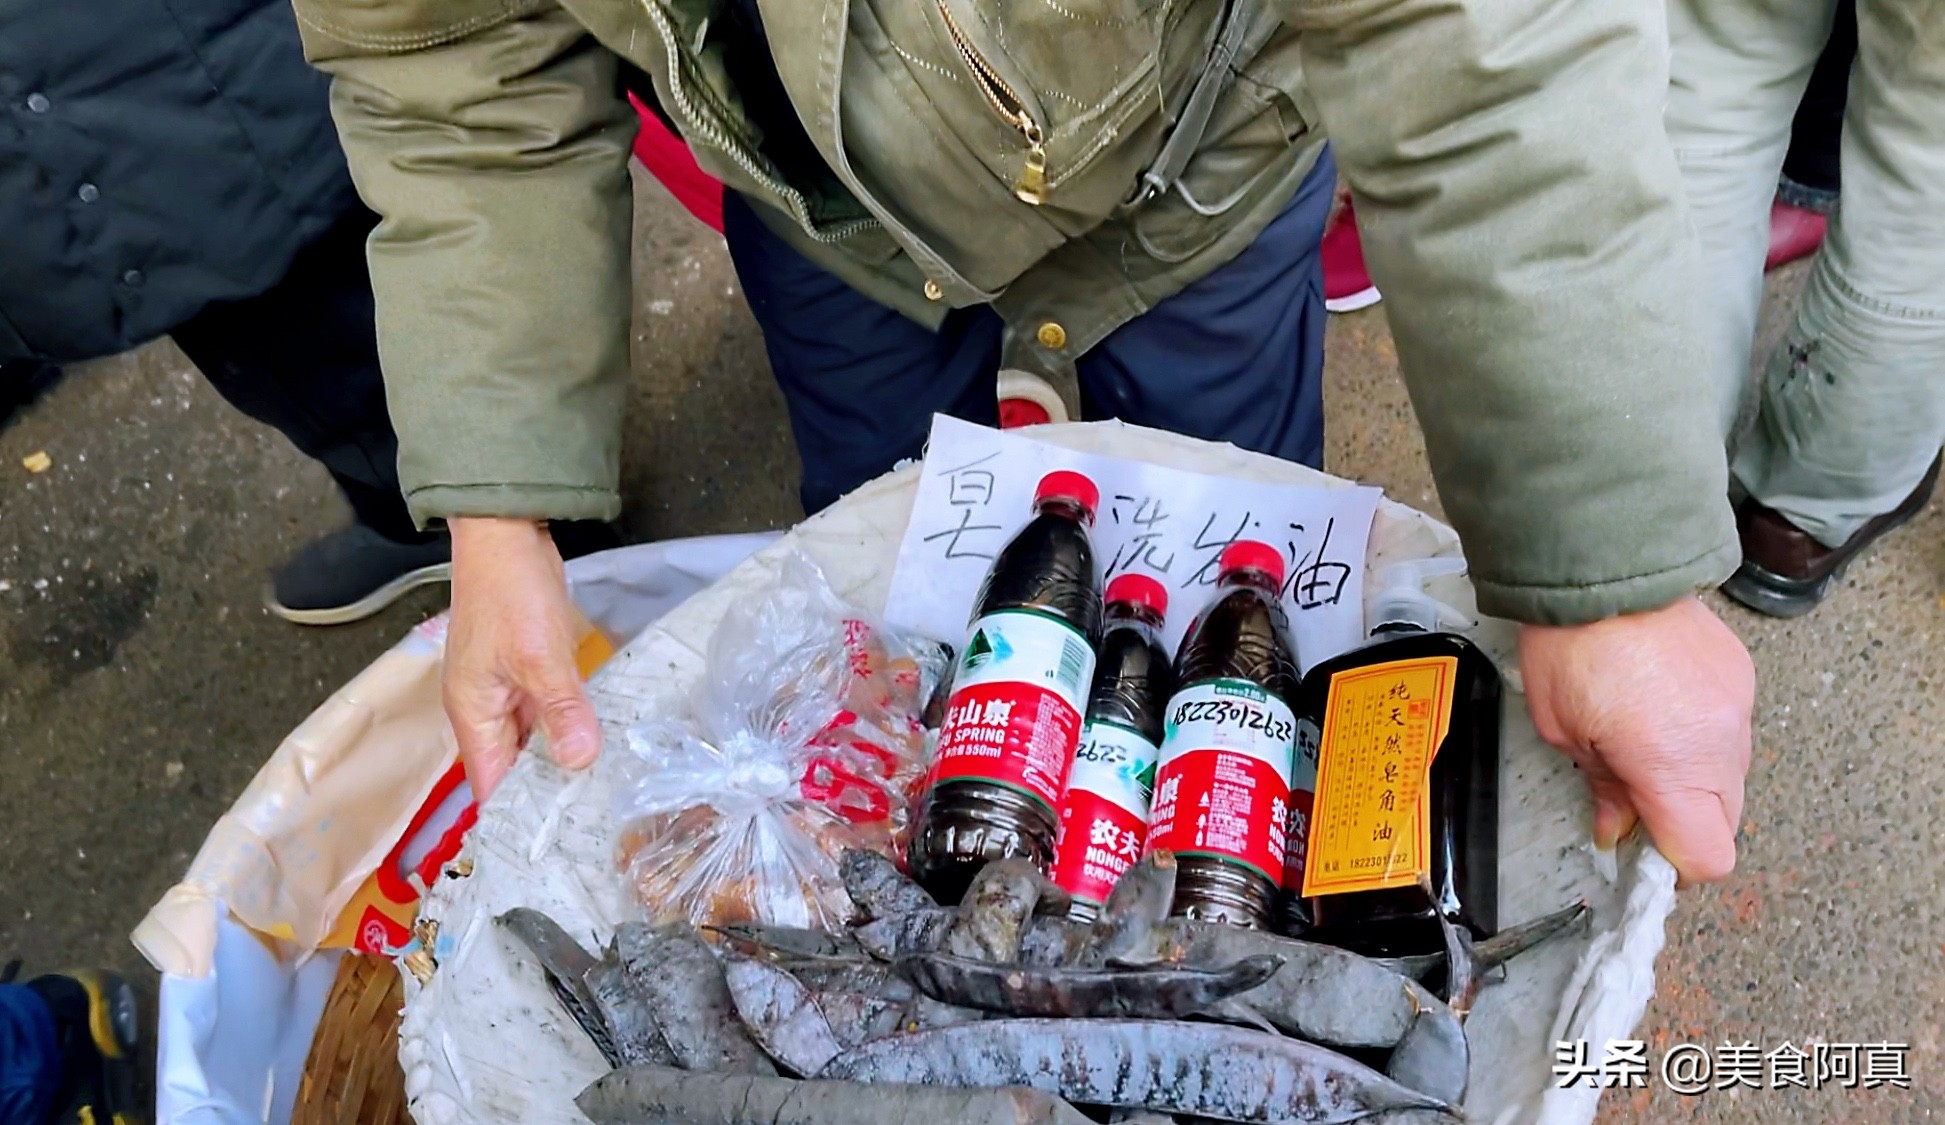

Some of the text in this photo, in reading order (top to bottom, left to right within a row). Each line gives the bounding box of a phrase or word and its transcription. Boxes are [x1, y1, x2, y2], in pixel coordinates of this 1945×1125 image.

[954, 727, 1006, 744] SPRING
[1173, 700, 1292, 742] 18223012622
[1373, 678, 1411, 841] 纯天然皂角油
[1090, 819, 1141, 863] 农夫
